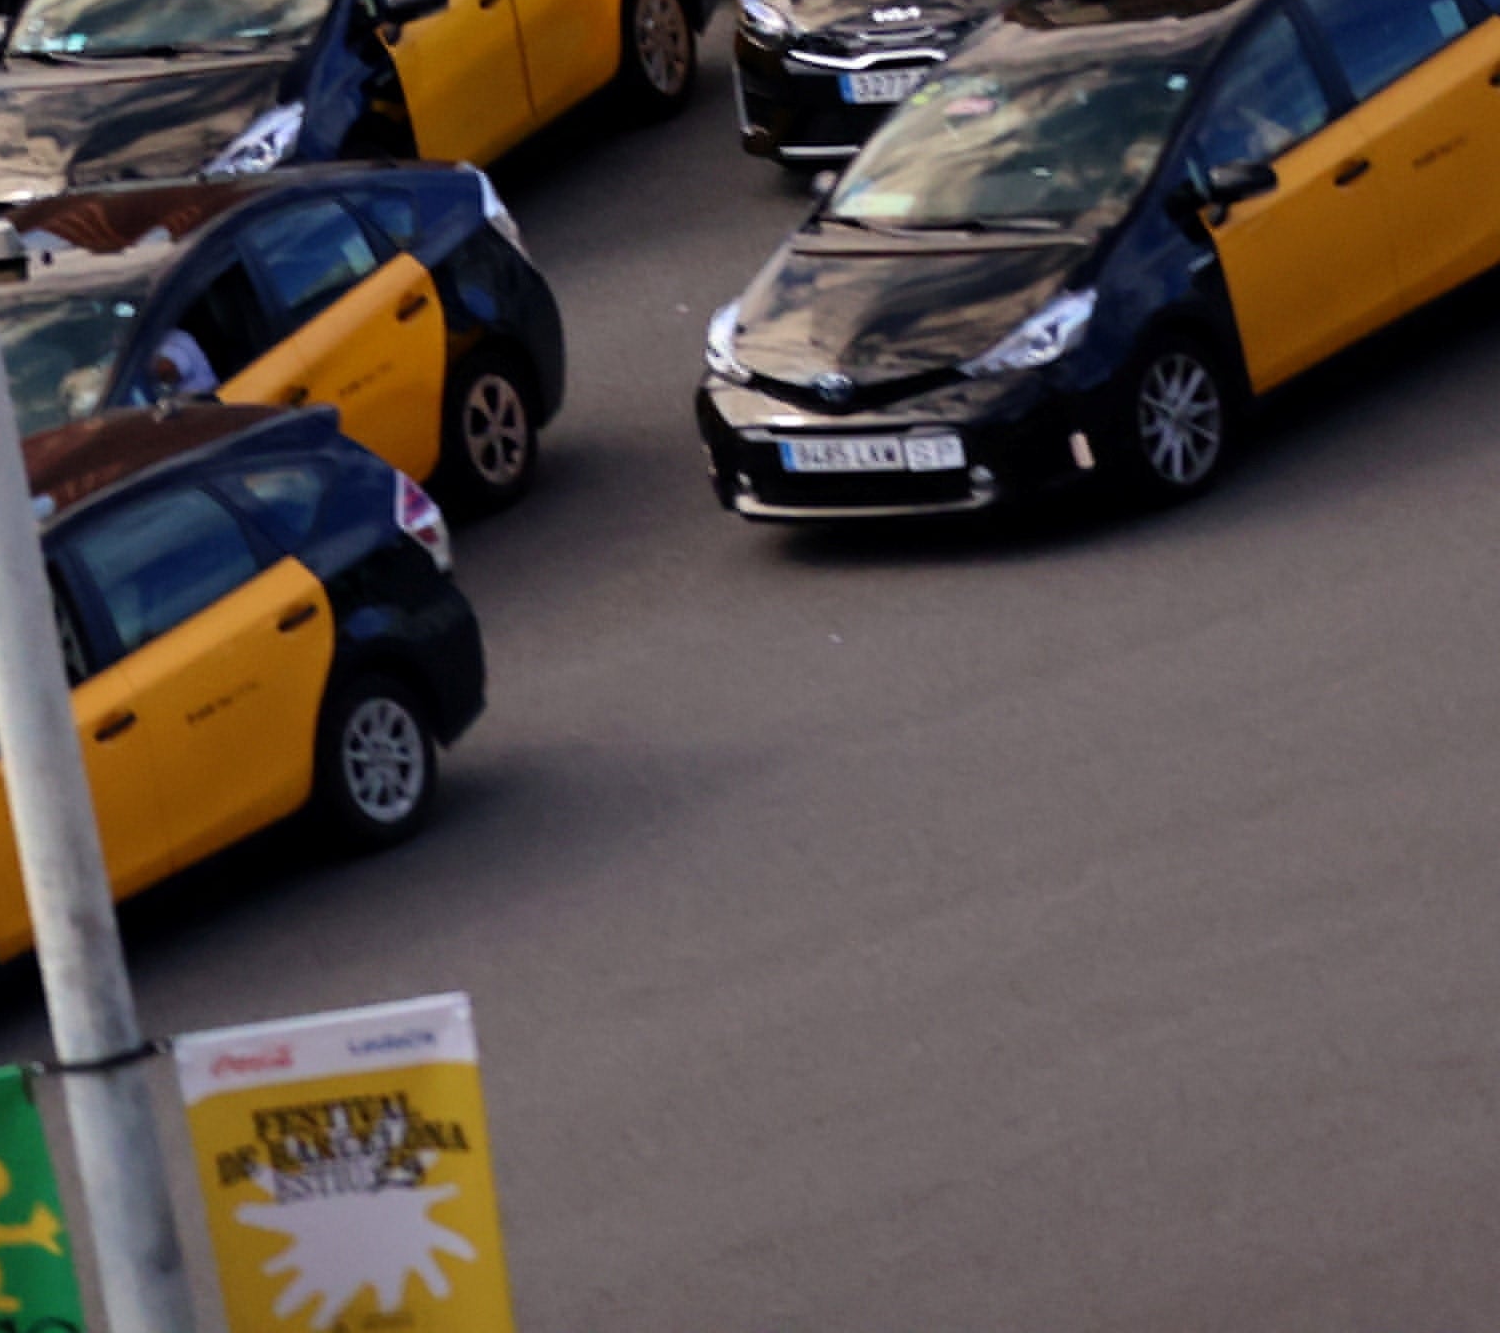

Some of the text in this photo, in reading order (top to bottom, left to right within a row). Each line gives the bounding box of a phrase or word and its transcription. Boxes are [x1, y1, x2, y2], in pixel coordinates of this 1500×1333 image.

[908, 441, 959, 465] SP
[253, 1092, 409, 1142] FESTIVAL
[216, 1117, 470, 1186] DE BARCELONA
